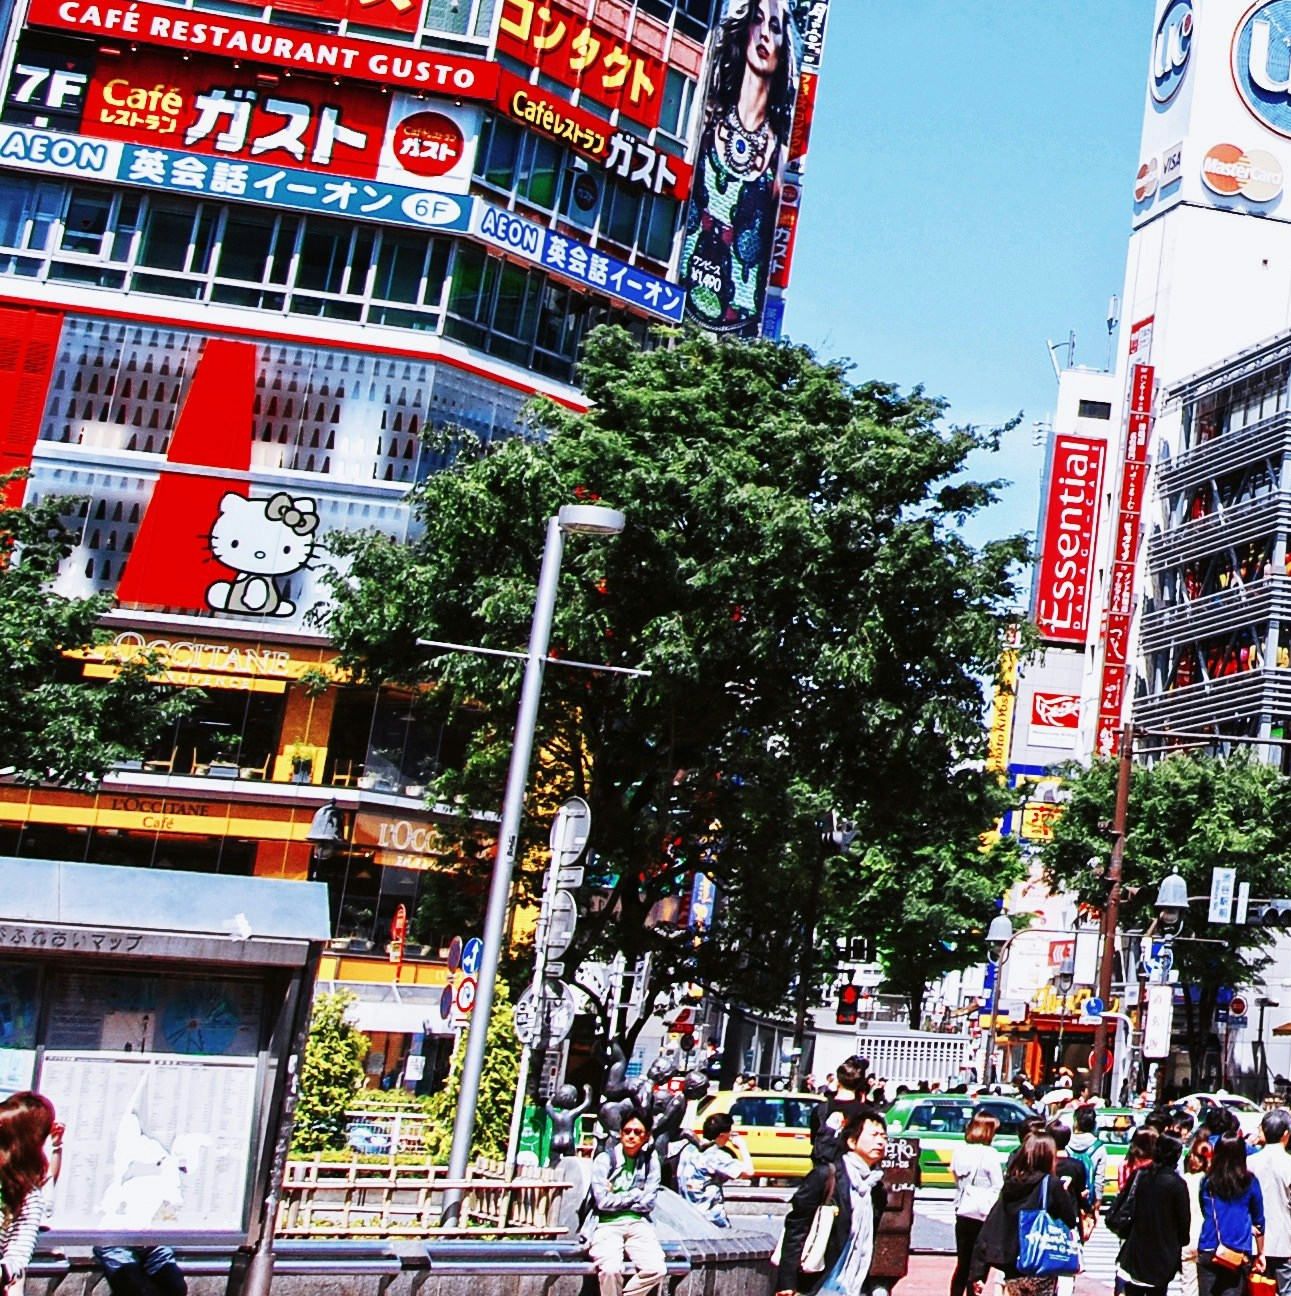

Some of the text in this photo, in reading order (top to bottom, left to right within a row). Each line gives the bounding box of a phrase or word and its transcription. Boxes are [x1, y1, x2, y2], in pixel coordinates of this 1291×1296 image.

[58, 0, 476, 89] CAFÉ RESTAURANT GUSTO
[14, 63, 88, 108] 7F
[102, 77, 183, 117] Café
[100, 108, 178, 135] レストラン
[183, 85, 369, 167] ガスト
[1, 130, 108, 171] AEON
[398, 137, 457, 161] ガスト
[605, 133, 677, 193] ガスト
[1163, 150, 1182, 175] VISA
[1203, 155, 1281, 186] MasterCard
[128, 147, 450, 220] 英会話イーオン 6F
[481, 207, 539, 254] AEON
[546, 234, 682, 312] 英会話イーオン
[1042, 441, 1091, 634] Essential
[111, 797, 209, 817] L'OCCITANE
[142, 816, 175, 831] Café
